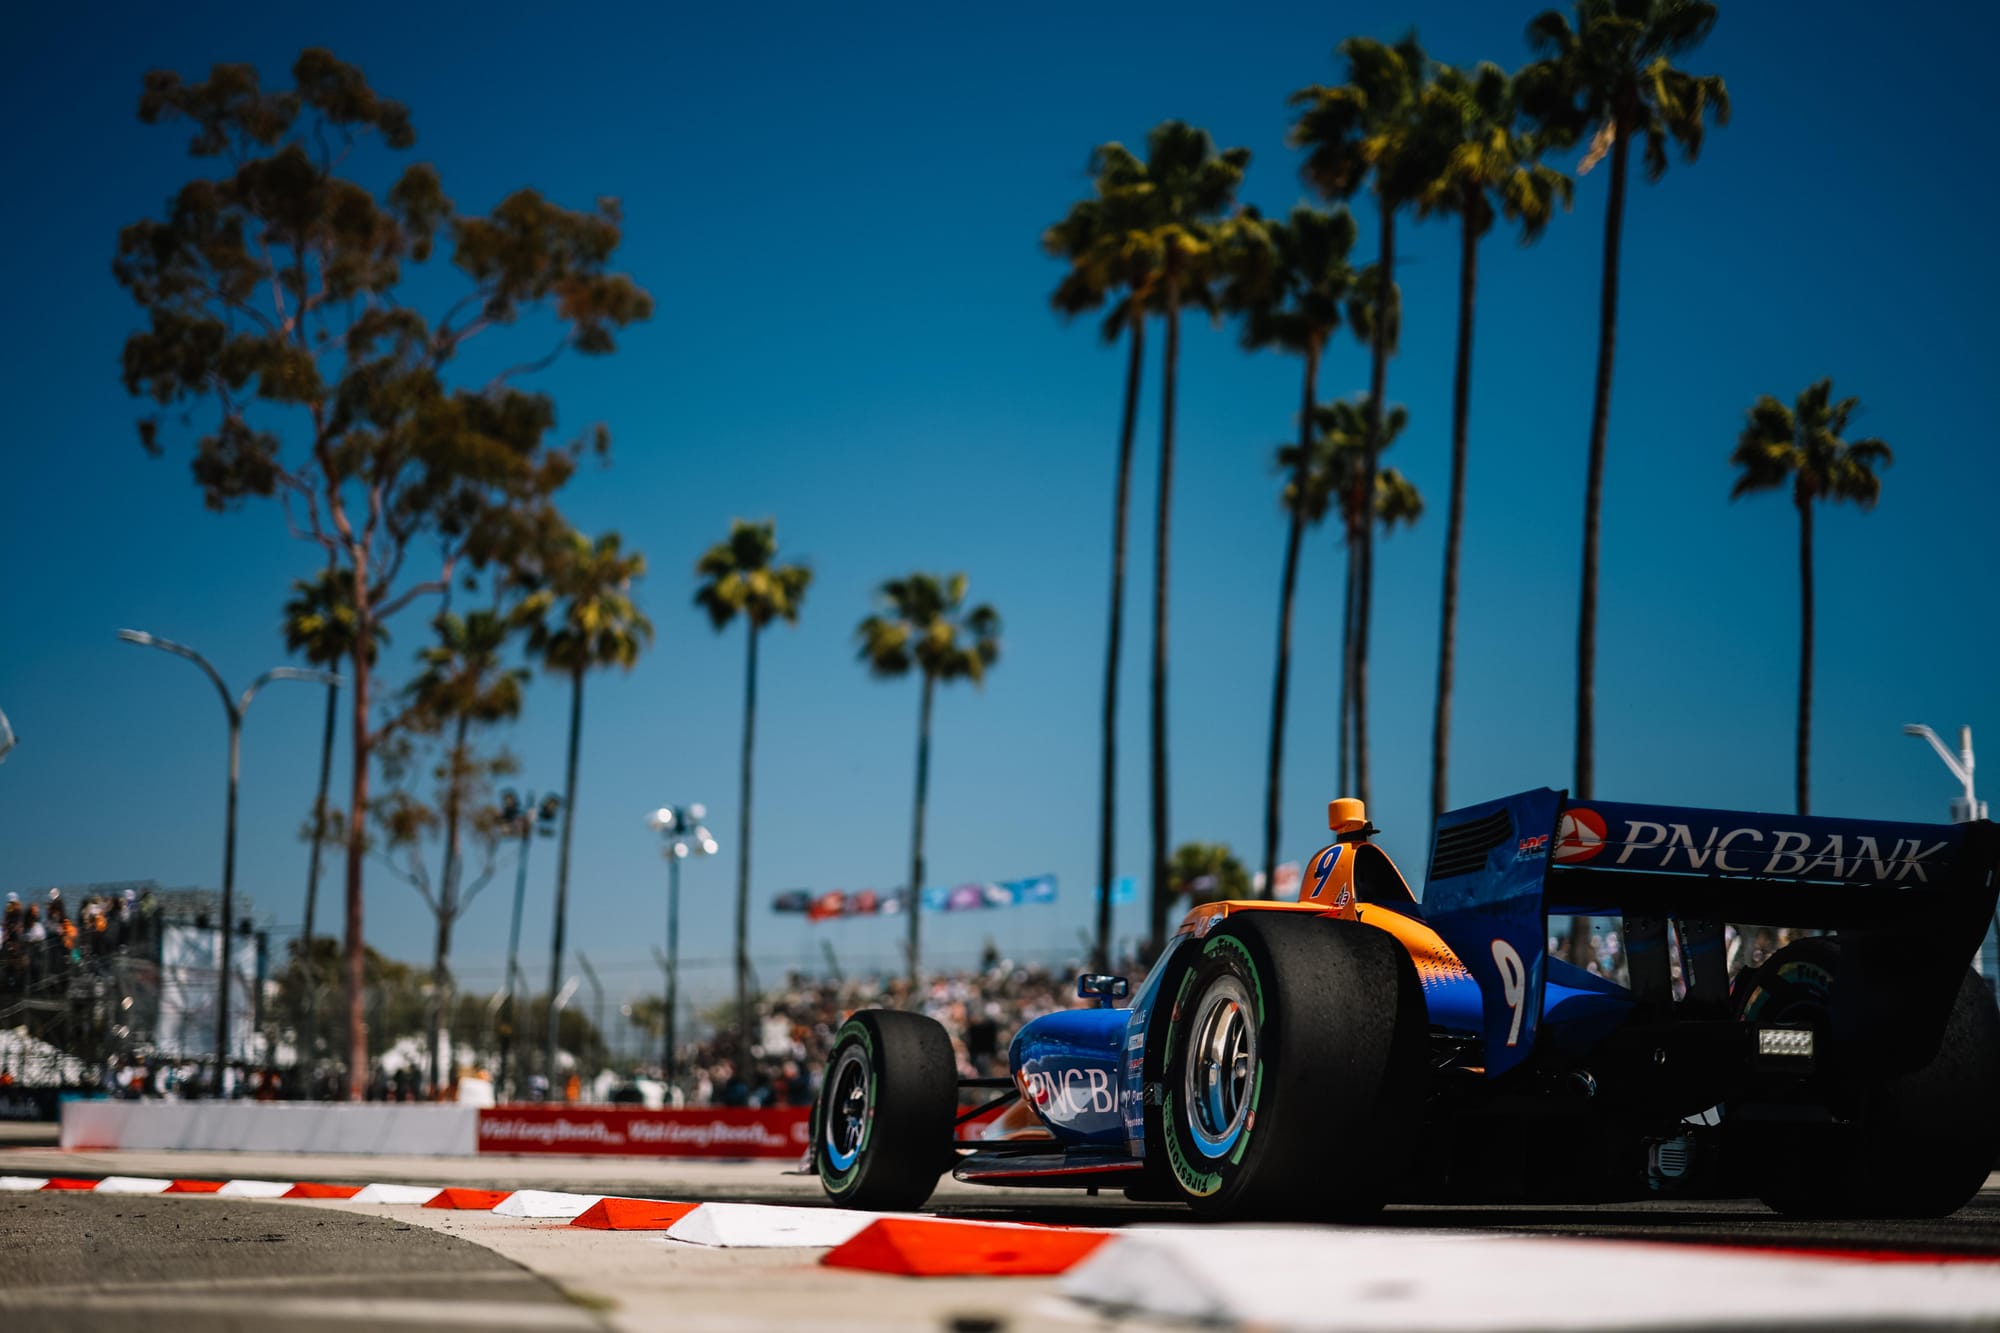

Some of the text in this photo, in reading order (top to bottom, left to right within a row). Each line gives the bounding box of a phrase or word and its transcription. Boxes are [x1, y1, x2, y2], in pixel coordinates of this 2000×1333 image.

[1310, 844, 1344, 899] 9
[1616, 820, 1950, 884] PNC BANK
[1490, 938, 1527, 1048] 9
